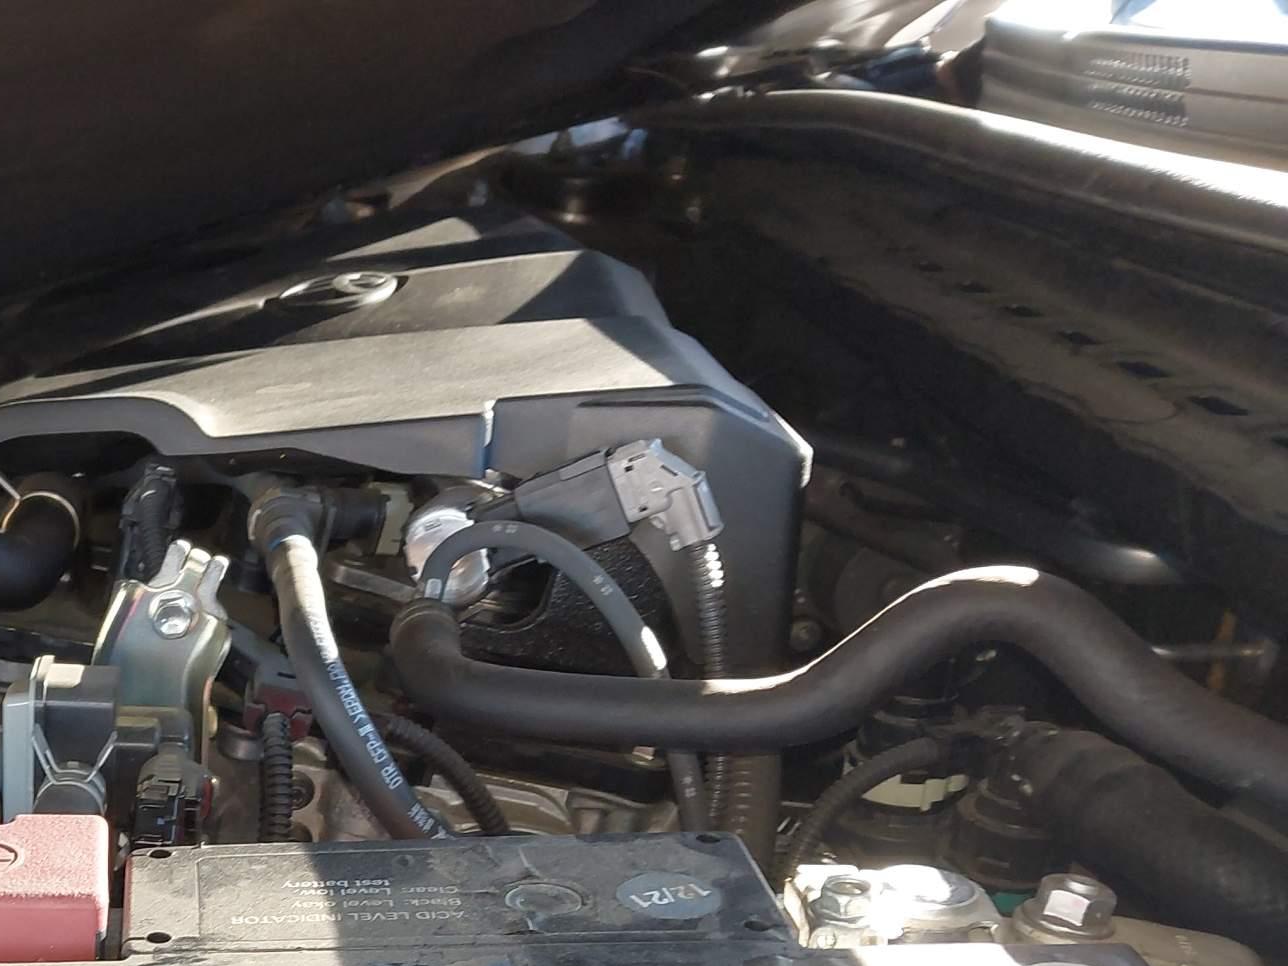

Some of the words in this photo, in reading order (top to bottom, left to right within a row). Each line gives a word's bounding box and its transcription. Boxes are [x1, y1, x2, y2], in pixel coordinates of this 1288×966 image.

[280, 879, 348, 890] battery
[354, 879, 390, 888] test
[340, 887, 392, 896] Level
[342, 899, 393, 909] Level
[229, 912, 342, 925] INDICATOR
[347, 911, 409, 922] LEVEL
[415, 910, 465, 921] ACID
